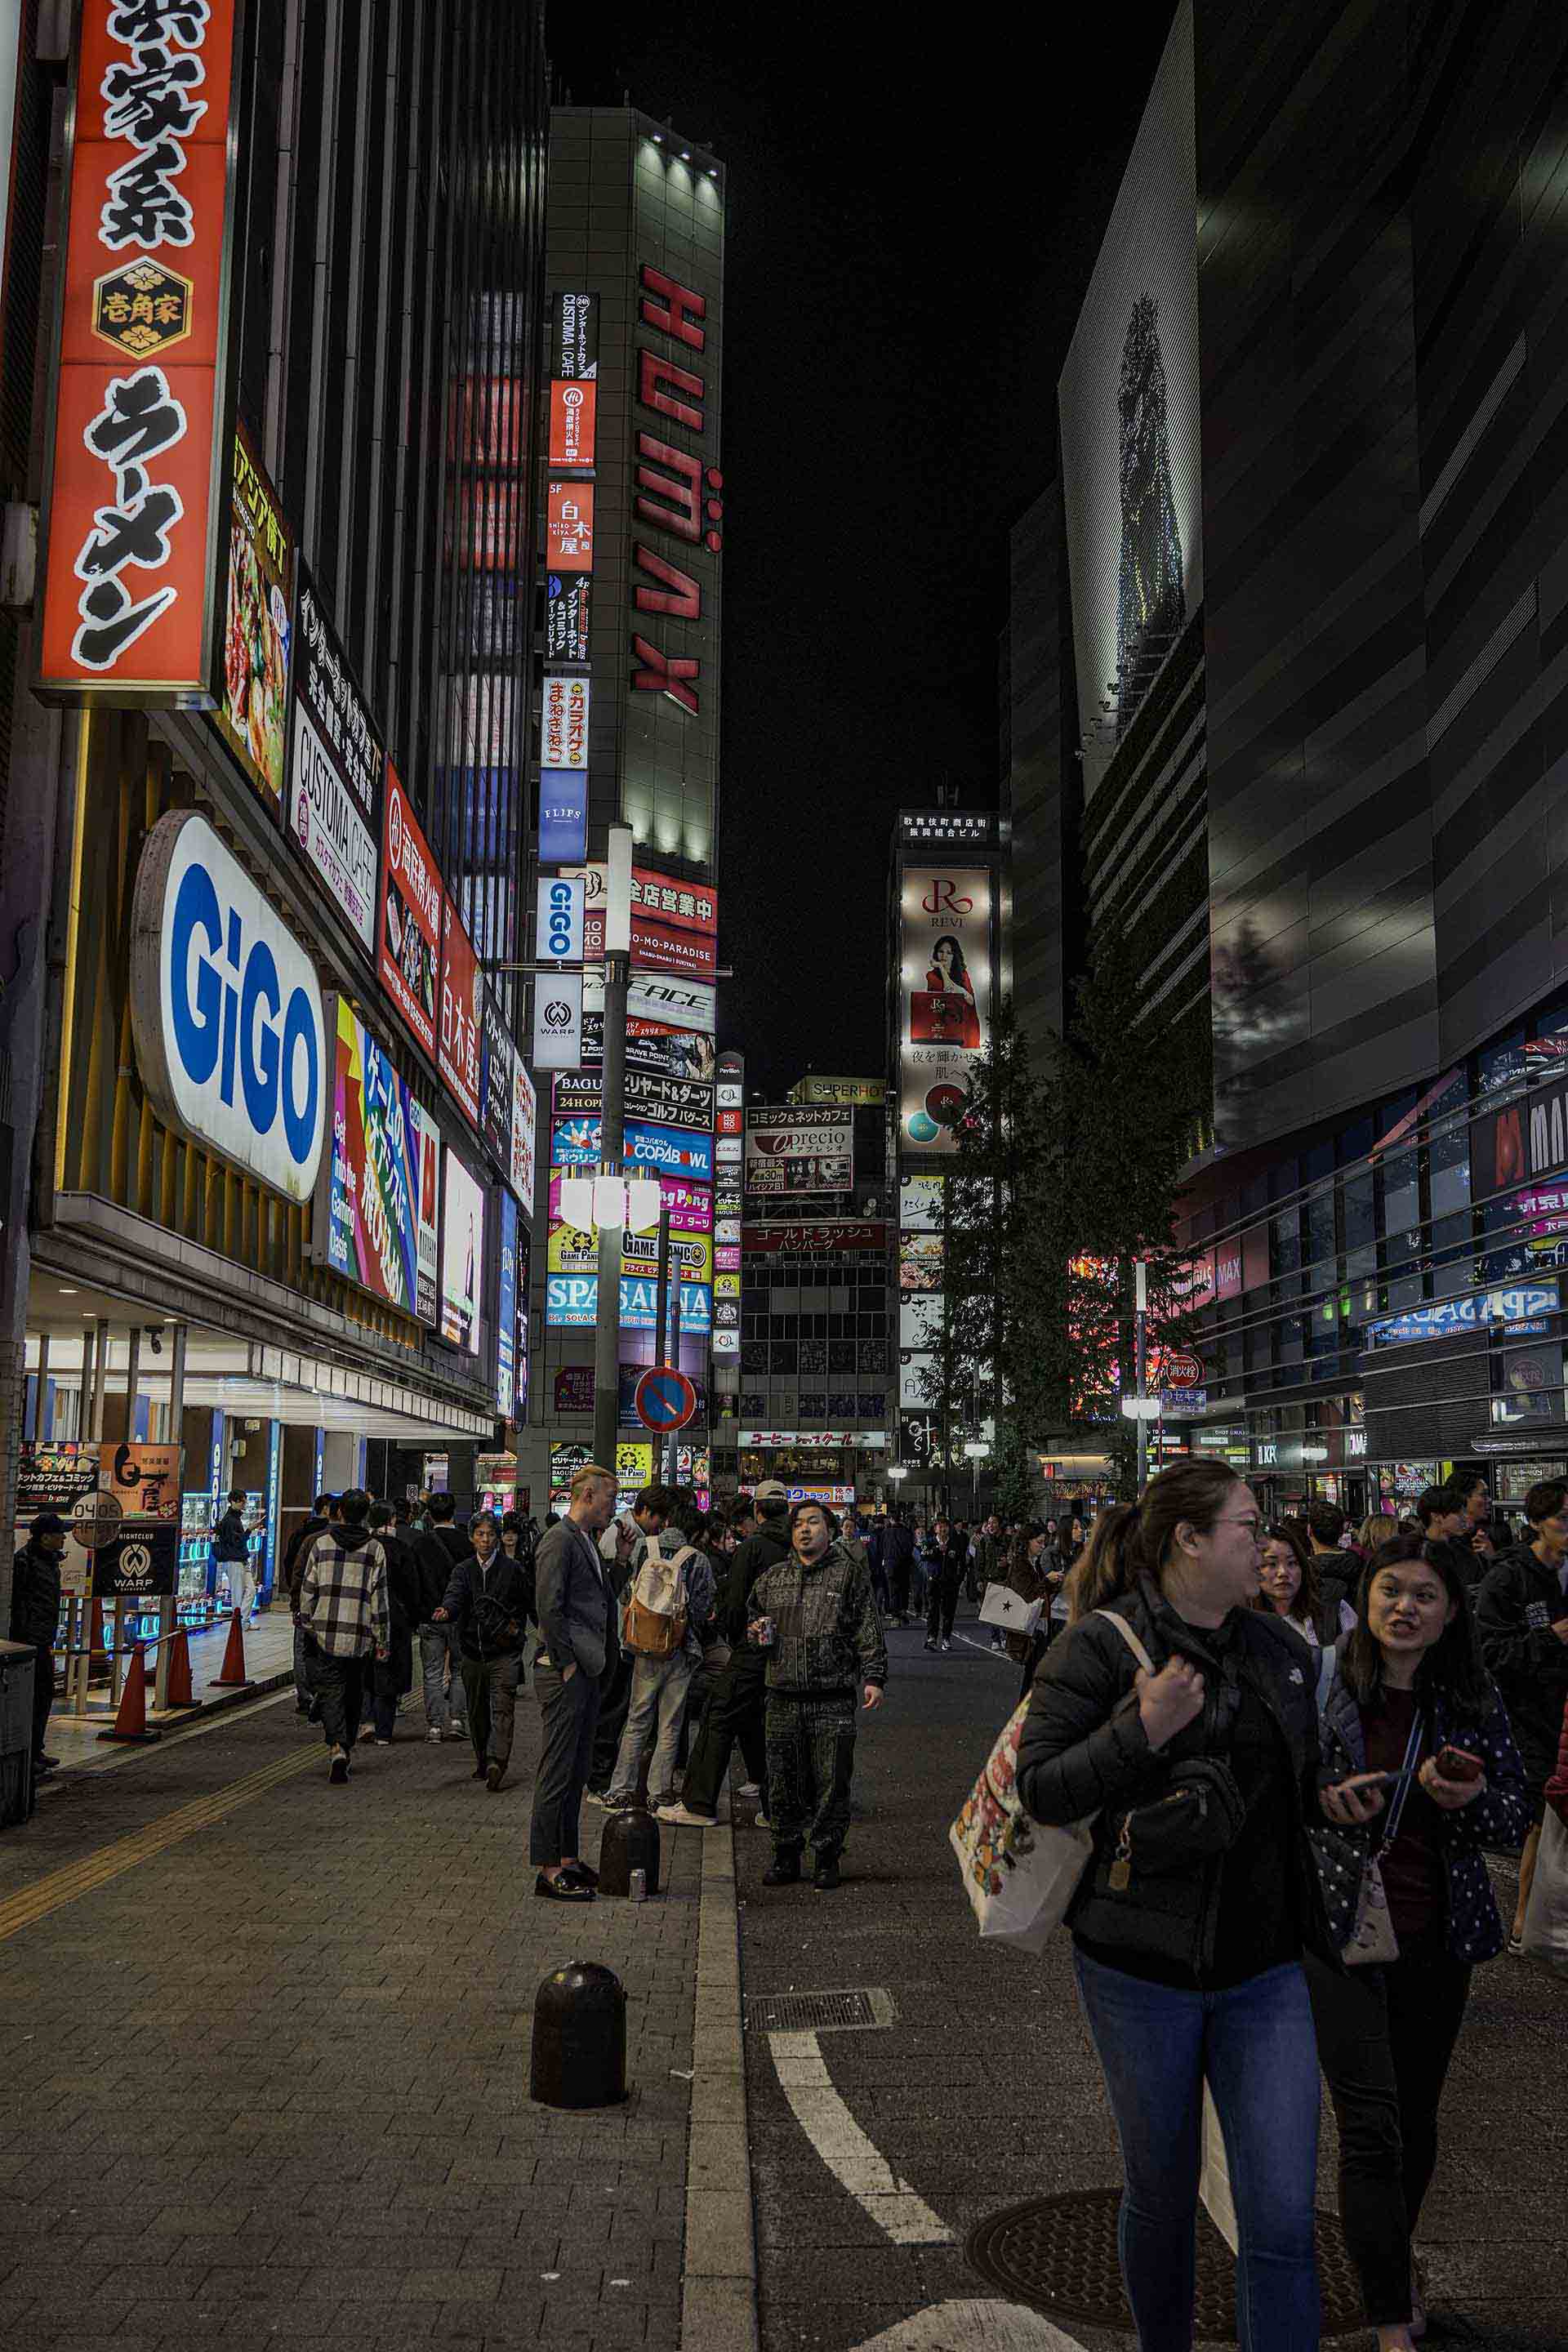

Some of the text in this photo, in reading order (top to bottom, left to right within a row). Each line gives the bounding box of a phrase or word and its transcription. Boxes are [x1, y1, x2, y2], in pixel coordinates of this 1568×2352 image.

[102, 291, 184, 325] 壱角家
[561, 294, 576, 377] CUSTOMA CAFE
[550, 483, 562, 493] 5F
[71, 365, 187, 670] ラーメン
[560, 501, 592, 555] 白木屋
[576, 576, 590, 589] 4F
[556, 601, 566, 650] &コミック
[568, 588, 577, 660] インターネット
[546, 681, 565, 765] まねきねこ
[568, 695, 586, 752] カラオケ
[301, 724, 372, 902] CUSTOMA CAFE
[544, 808, 582, 820] FLIPS
[903, 817, 987, 828] 歌舞伎町商店街
[910, 827, 981, 837] 振興組合ビル
[628, 876, 712, 922] 全店営業中
[548, 882, 572, 955] GiGO
[931, 917, 964, 928] REVI
[631, 933, 711, 961] O-MO-PARADISE
[171, 863, 318, 1165] GiGO
[442, 960, 475, 1094] 白木屋
[626, 1046, 669, 1062] BRAVE POINT
[561, 1079, 602, 1089] BAGU
[368, 1038, 403, 1157] ゲームの
[559, 1098, 582, 1107] 24H
[648, 1103, 677, 1120] ゴルフ
[679, 1110, 710, 1126] バグース
[749, 1110, 850, 1125] コミック&ネットカフェ
[335, 1111, 346, 1145] Get
[1530, 1091, 1568, 1174] MA
[772, 1128, 844, 1153] aprecio
[559, 1153, 601, 1163] ボウリン
[750, 1157, 784, 1169] 新宿最大
[334, 1149, 357, 1193] into the
[371, 1110, 407, 1235] オアシスに
[660, 1190, 675, 1207] ng
[331, 1188, 355, 1237] Gaming
[687, 1217, 710, 1227] ダーツ
[329, 1227, 347, 1262] Oasis
[622, 1230, 691, 1261] GAME ANIC
[756, 1227, 873, 1241] ゴールドラッシュ
[779, 1239, 836, 1250] ハンバーグ
[561, 1250, 580, 1260] GAME
[625, 1263, 645, 1273] プライズ
[1169, 1365, 1196, 1378] 消火栓
[551, 1456, 594, 1465] ビリヤード&ダー
[628, 1468, 646, 1477] PANIC
[113, 1578, 154, 1588] WARP
